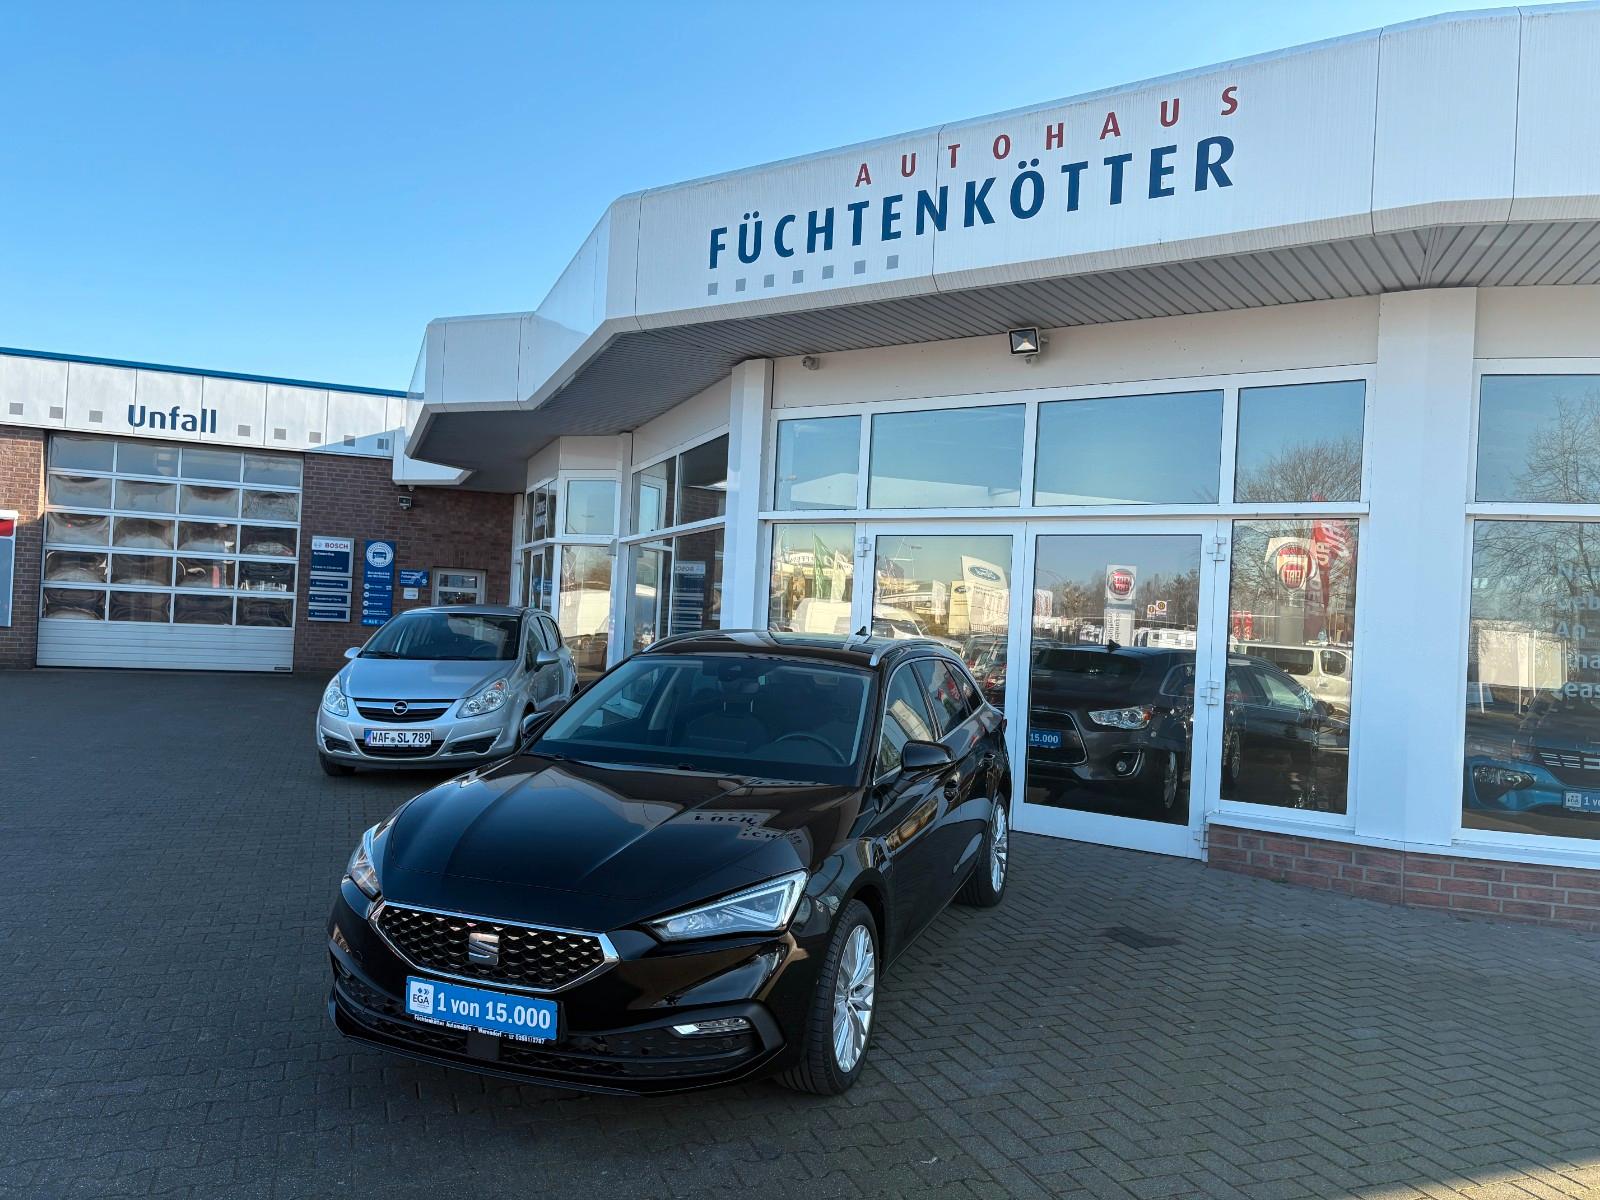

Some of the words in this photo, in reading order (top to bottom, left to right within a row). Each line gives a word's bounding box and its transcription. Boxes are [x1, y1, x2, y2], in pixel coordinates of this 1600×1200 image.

[855, 86, 1239, 188] AUTOHAUS
[709, 135, 1236, 269] FÜCHTENKÖTTER
[127, 404, 217, 434] Unfall
[325, 542, 349, 550] BOSCH
[371, 731, 391, 744] WAF
[397, 732, 410, 744] SL
[412, 732, 431, 744] 789
[1031, 733, 1059, 744] 15.000
[412, 993, 430, 1006] EGA
[437, 992, 447, 1012] 1
[450, 998, 480, 1018] von
[485, 1001, 551, 1029] 15.000
